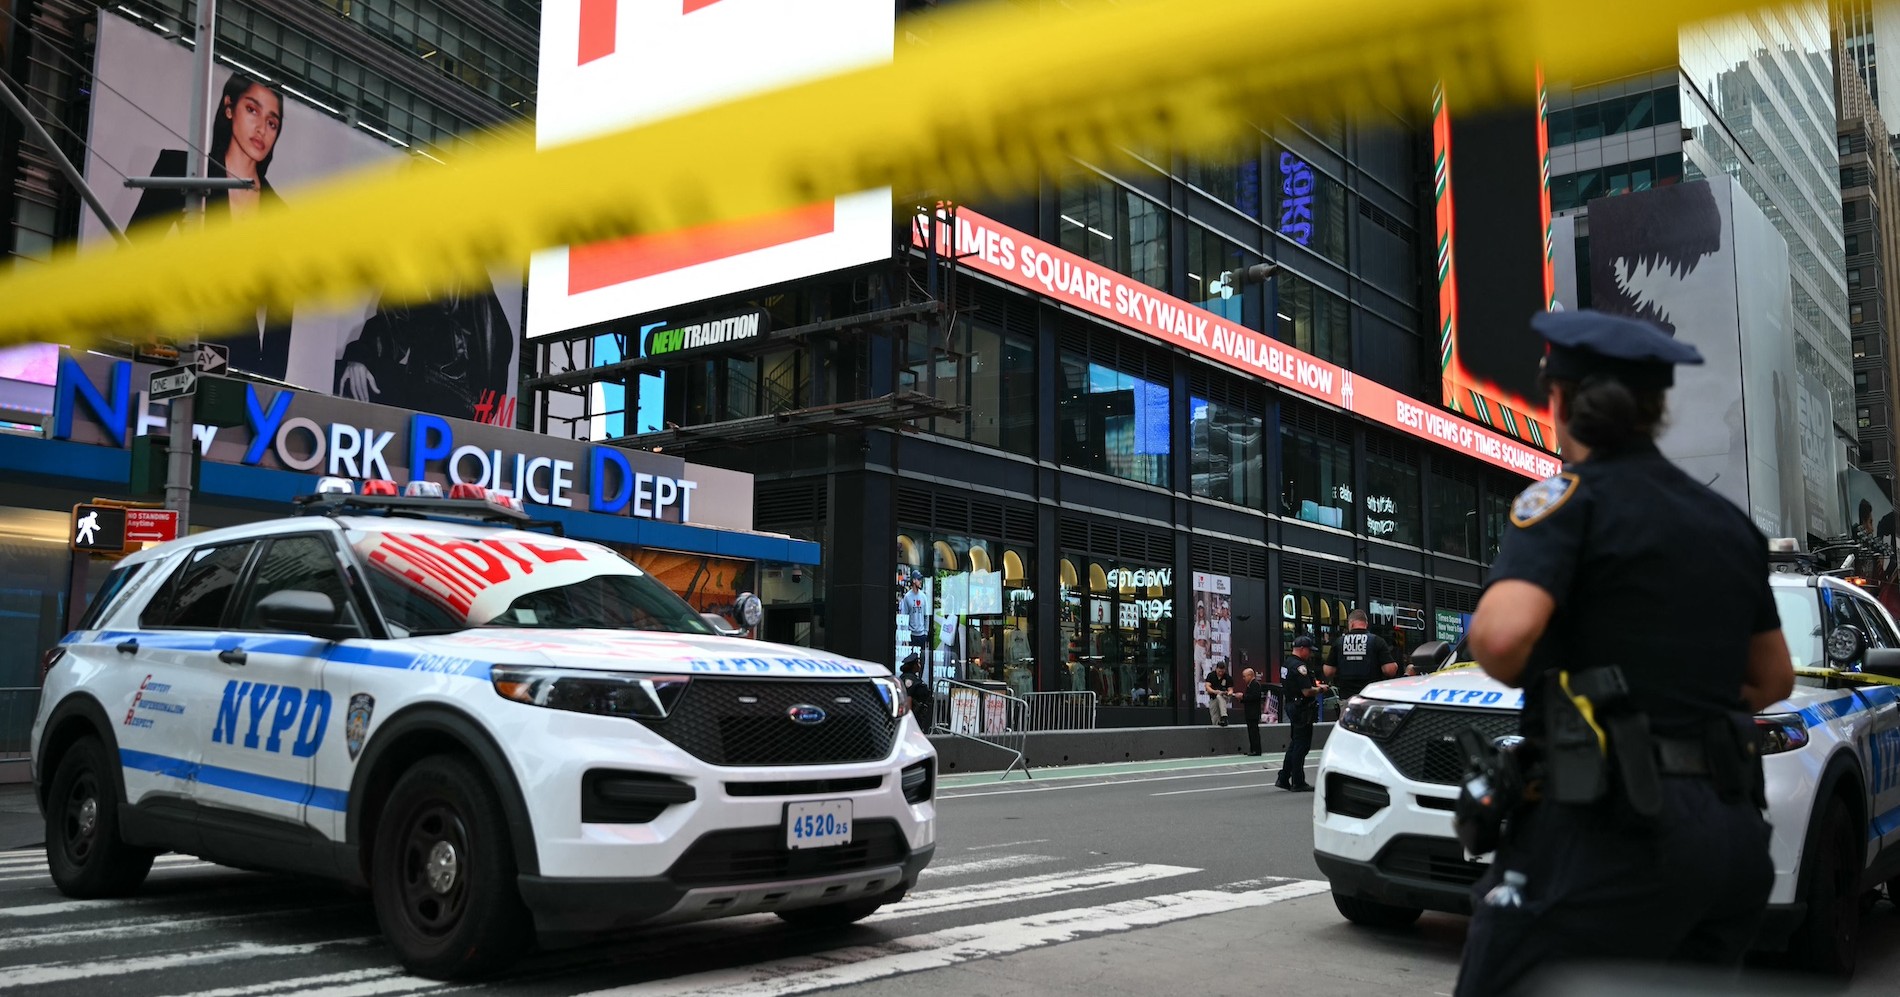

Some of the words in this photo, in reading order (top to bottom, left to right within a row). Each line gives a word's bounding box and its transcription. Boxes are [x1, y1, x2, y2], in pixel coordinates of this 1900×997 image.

[1020, 245, 1111, 309] SQUARE
[1115, 284, 1209, 347] SKYWALK
[1211, 323, 1295, 381] AVAILABLE
[1297, 359, 1333, 395] NOW
[196, 350, 215, 363] AY
[152, 378, 167, 391] ONE
[174, 374, 190, 387] WAY
[1396, 400, 1423, 431] BEST
[1425, 413, 1458, 443] VIEWS
[1459, 426, 1473, 449] OF
[1473, 433, 1501, 459] TIMES
[1501, 443, 1535, 474] SQUARE
[1535, 456, 1555, 478] HERE
[241, 381, 396, 481] YORK
[408, 413, 574, 508] POLICE
[588, 445, 697, 523] DEPT
[127, 520, 155, 528] Anytime
[138, 513, 170, 521] STANDING
[1343, 633, 1368, 644] NYPD
[1343, 643, 1366, 652] POLICE
[410, 653, 470, 676] POLICE
[690, 656, 771, 672] NYPD
[774, 657, 866, 674] POLICE
[1420, 688, 1503, 705] NYPD
[212, 679, 332, 758] NYPD
[794, 812, 835, 838] 4520
[836, 822, 848, 835] 25
